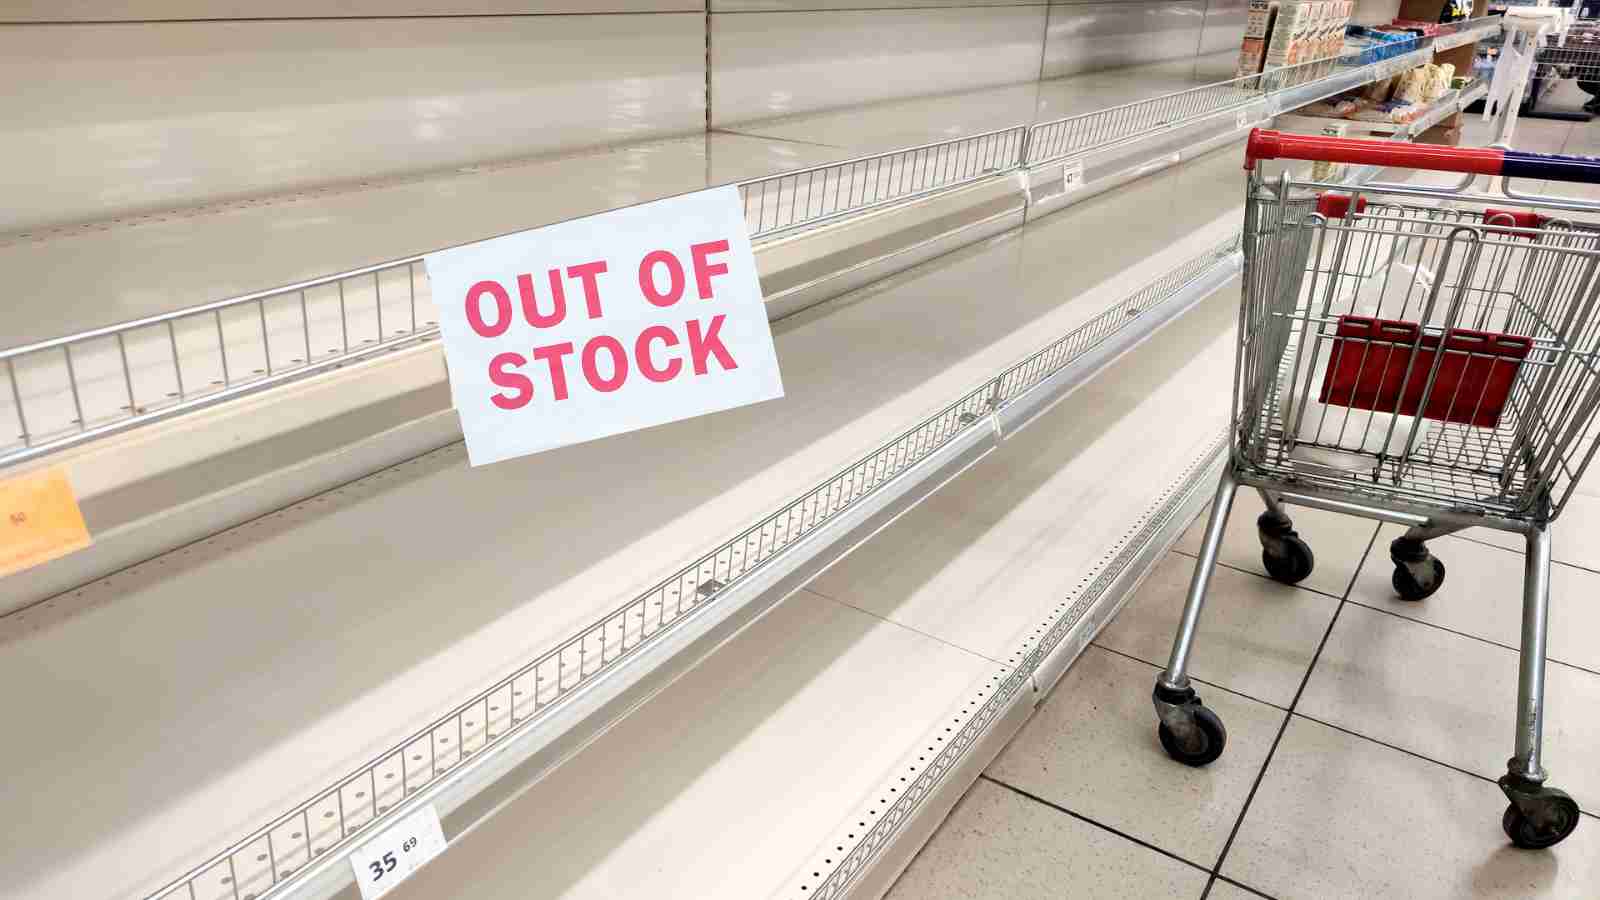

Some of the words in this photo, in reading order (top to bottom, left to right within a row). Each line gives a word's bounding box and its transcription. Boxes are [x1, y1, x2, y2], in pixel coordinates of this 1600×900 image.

[465, 261, 608, 338] OUT
[638, 239, 730, 308] OF
[488, 314, 738, 411] STOCK
[369, 851, 398, 882] 35
[402, 836, 417, 853] 69
